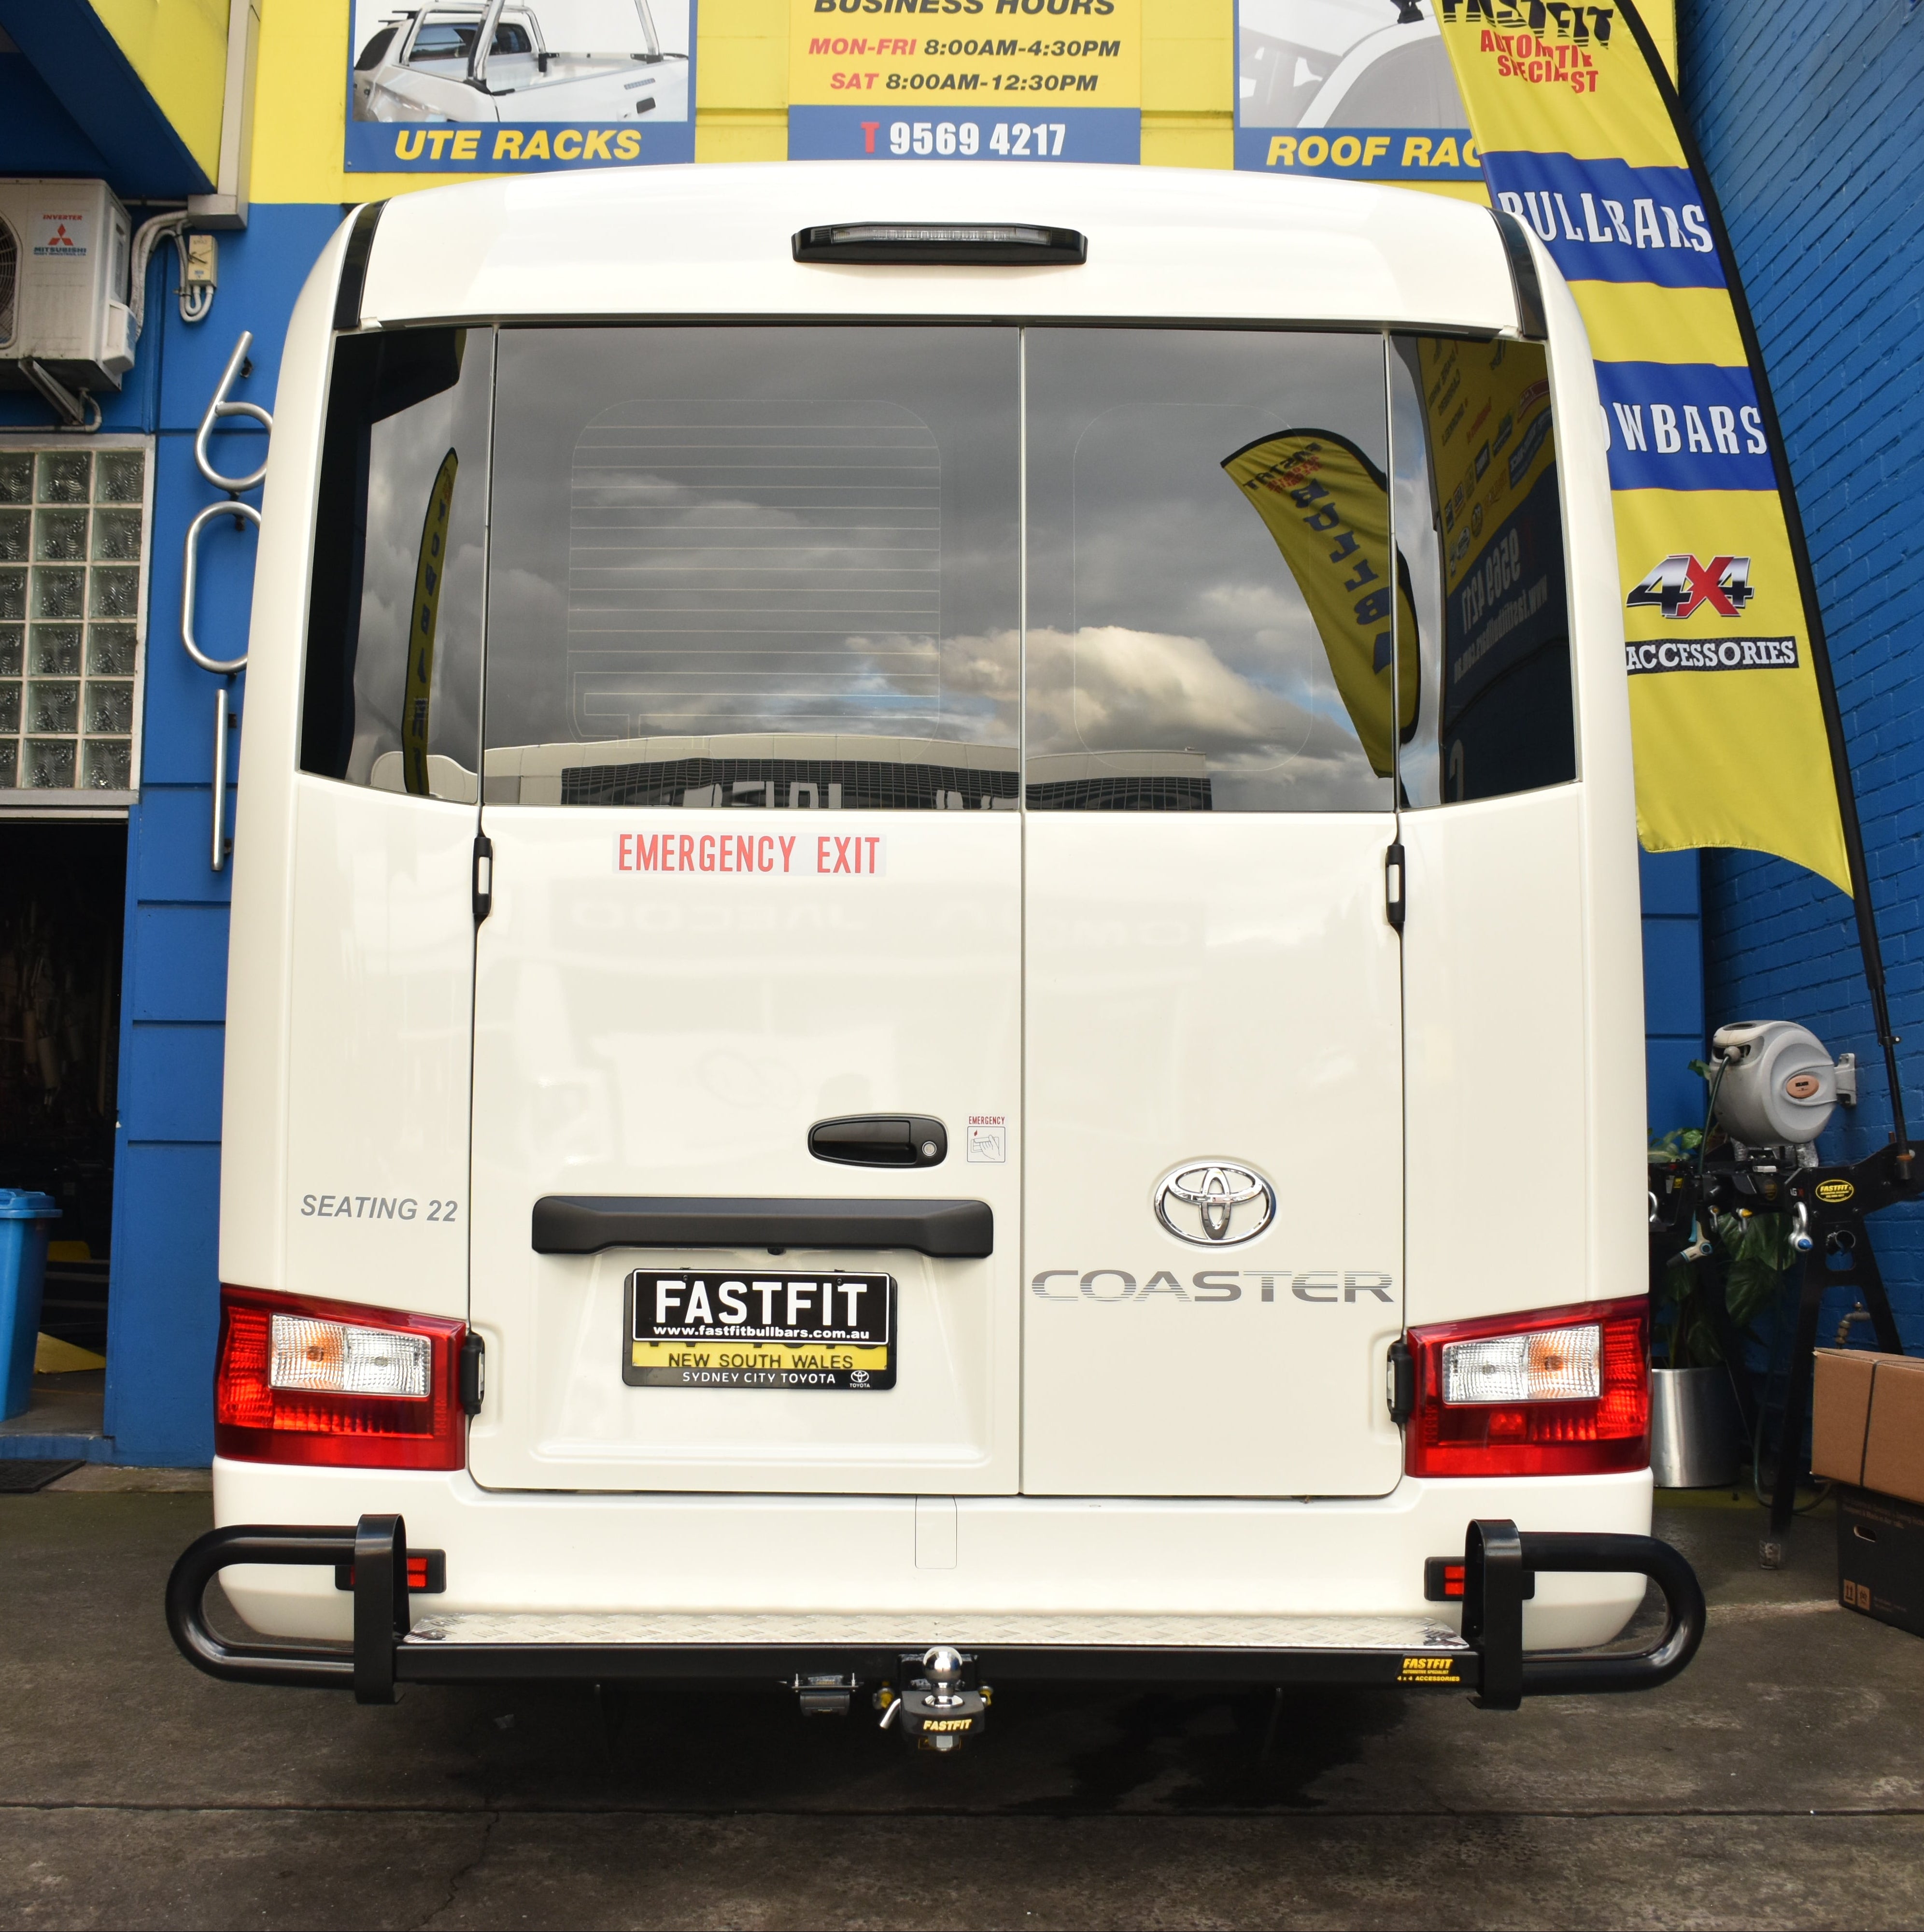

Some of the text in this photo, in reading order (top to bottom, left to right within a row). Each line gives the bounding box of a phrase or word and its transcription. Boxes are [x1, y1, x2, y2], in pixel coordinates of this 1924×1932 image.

[814, 0, 1115, 15] BUSINESS HOURS
[808, 38, 1120, 57] MON-FRI 8:00AM-4:30PM
[830, 73, 1098, 91] SAT 8:00AM-12:30PM
[395, 130, 642, 160] UTE RACKS
[861, 122, 1065, 155] T 9569 4217
[1266, 136, 1481, 167] ROOF RAC
[1498, 191, 1713, 253] BULLBARS
[1599, 402, 1767, 454] WBARS
[1626, 640, 1796, 670] ACCESSORIES
[619, 834, 880, 874] EMERGENCY EXIT
[968, 1116, 1005, 1125] EMERGENCY
[301, 1194, 458, 1222] SEATING 22
[1032, 1269, 1395, 1303] COASTER
[656, 1280, 867, 1327] FASTFIT
[653, 1325, 870, 1339] www.fastfitbullbars.com.au
[669, 1353, 854, 1369] NEW SOUTH WALES
[683, 1372, 835, 1384] SYDNEY CITY TOYOTA
[1403, 1658, 1453, 1669] FASTFIT
[923, 1719, 973, 1732] FASTFIT
